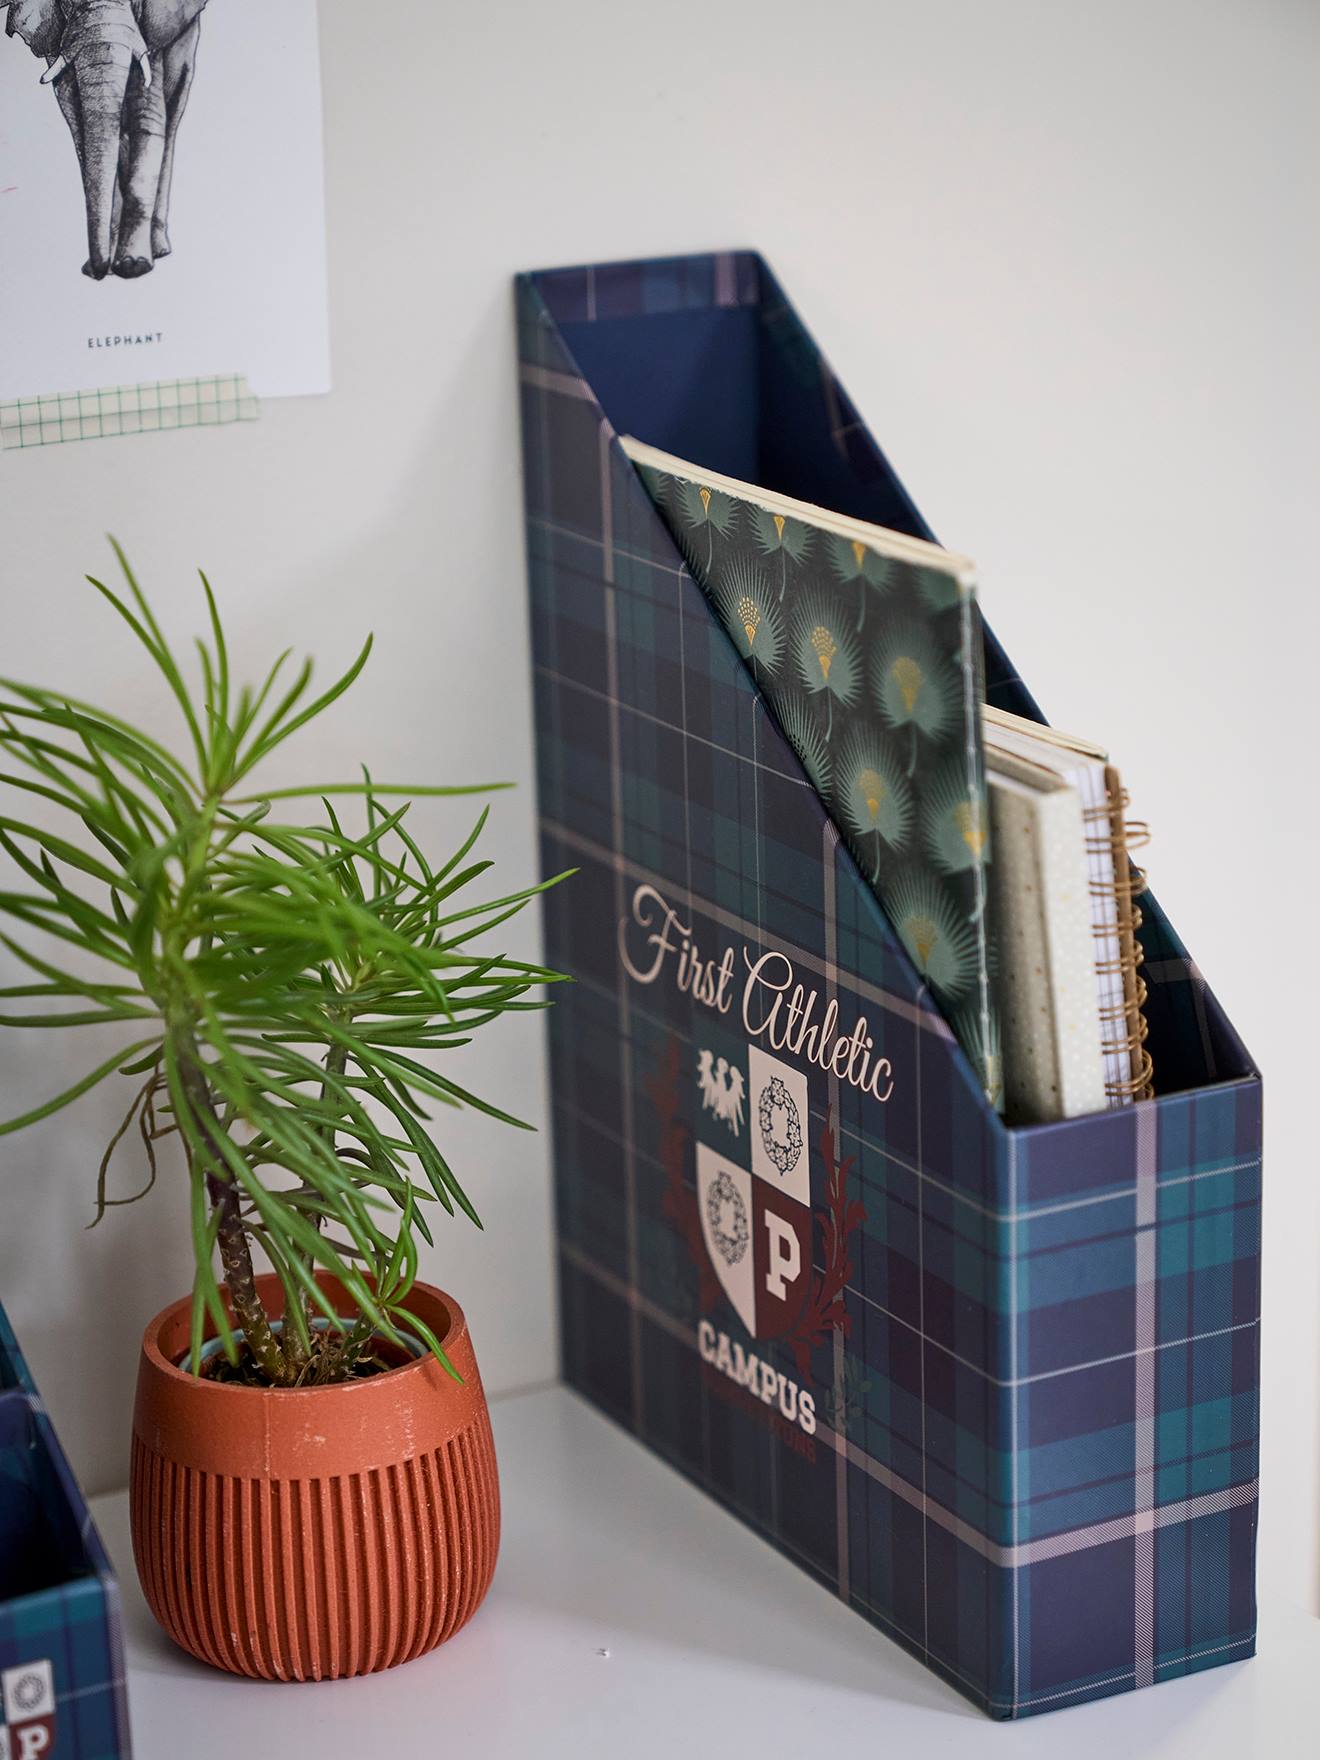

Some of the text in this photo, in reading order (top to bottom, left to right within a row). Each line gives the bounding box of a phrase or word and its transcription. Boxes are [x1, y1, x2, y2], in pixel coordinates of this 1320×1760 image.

[87, 332, 162, 348] ELEPHANT
[617, 884, 894, 1102] First Athletic
[764, 1208, 801, 1301] P
[698, 1319, 816, 1435] CAMPUS
[17, 1725, 49, 1760] P
